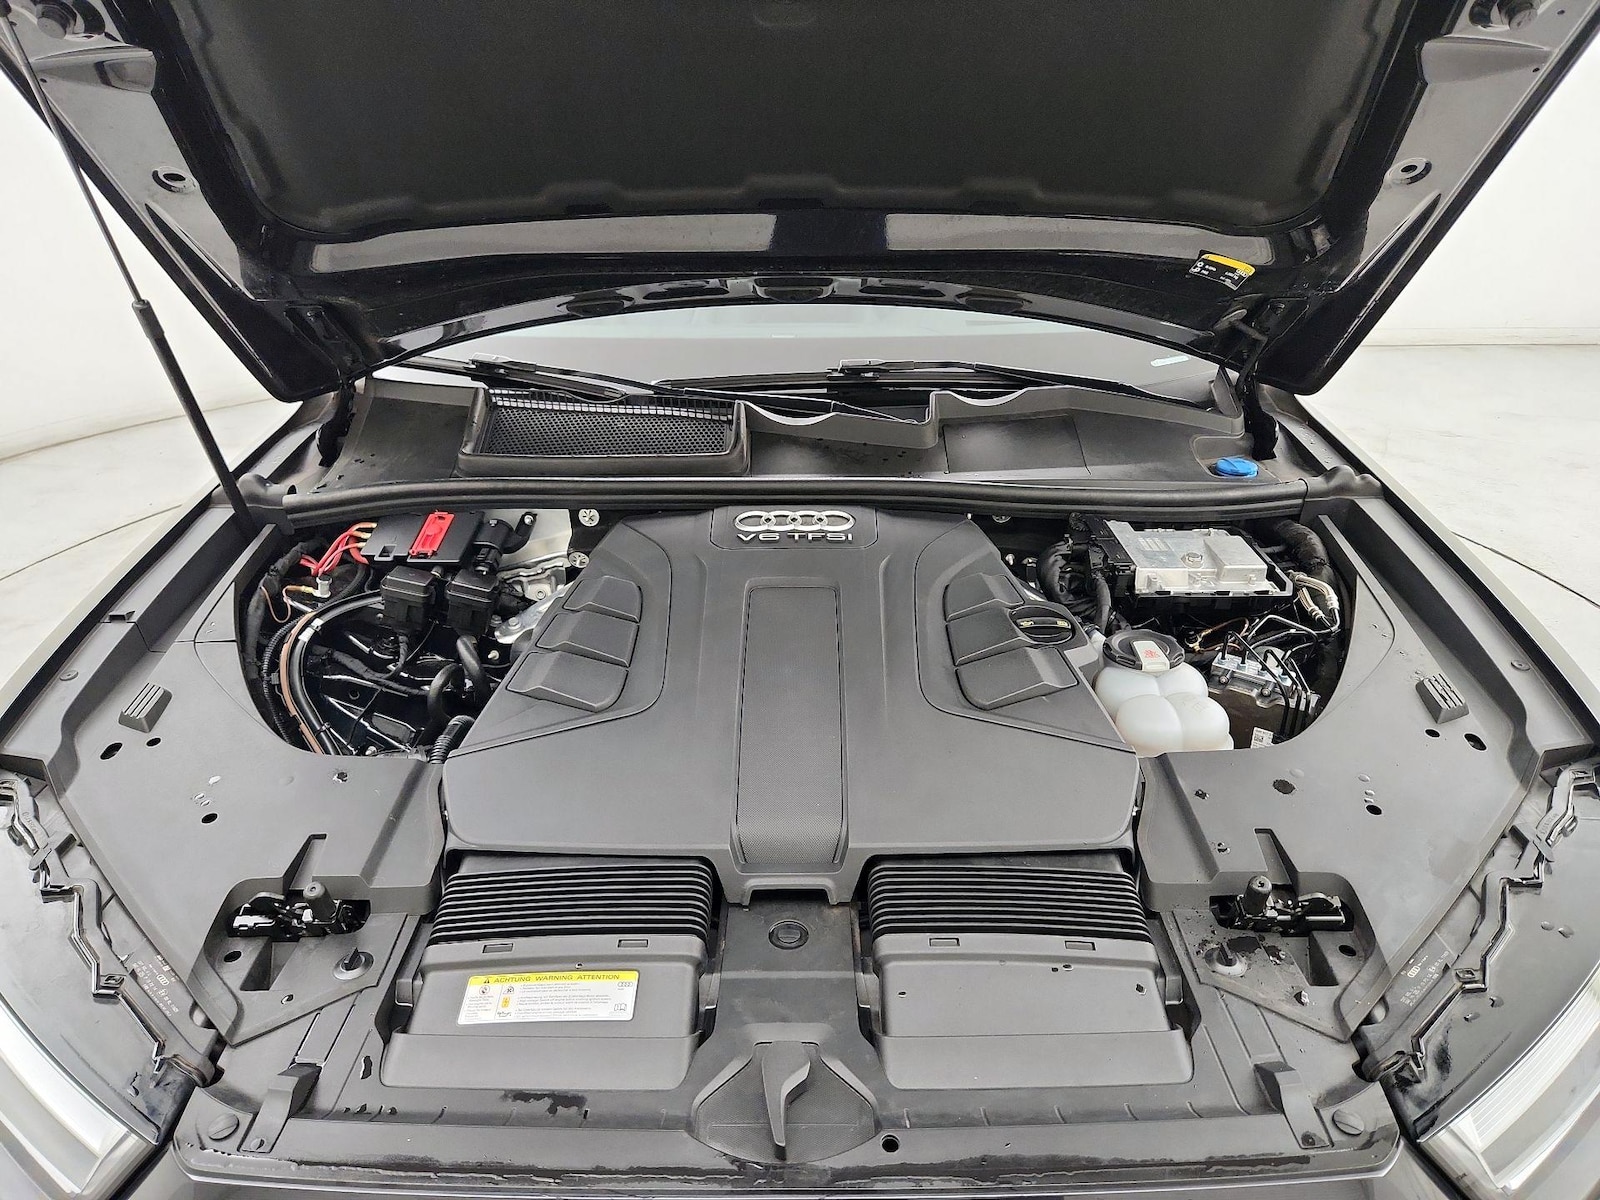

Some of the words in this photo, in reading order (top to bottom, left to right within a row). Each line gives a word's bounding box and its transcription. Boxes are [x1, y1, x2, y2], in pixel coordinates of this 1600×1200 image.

[737, 532, 780, 542] V6
[787, 532, 854, 542] TFSI
[493, 976, 531, 984] ACHTUNG
[535, 974, 573, 982] WARNING
